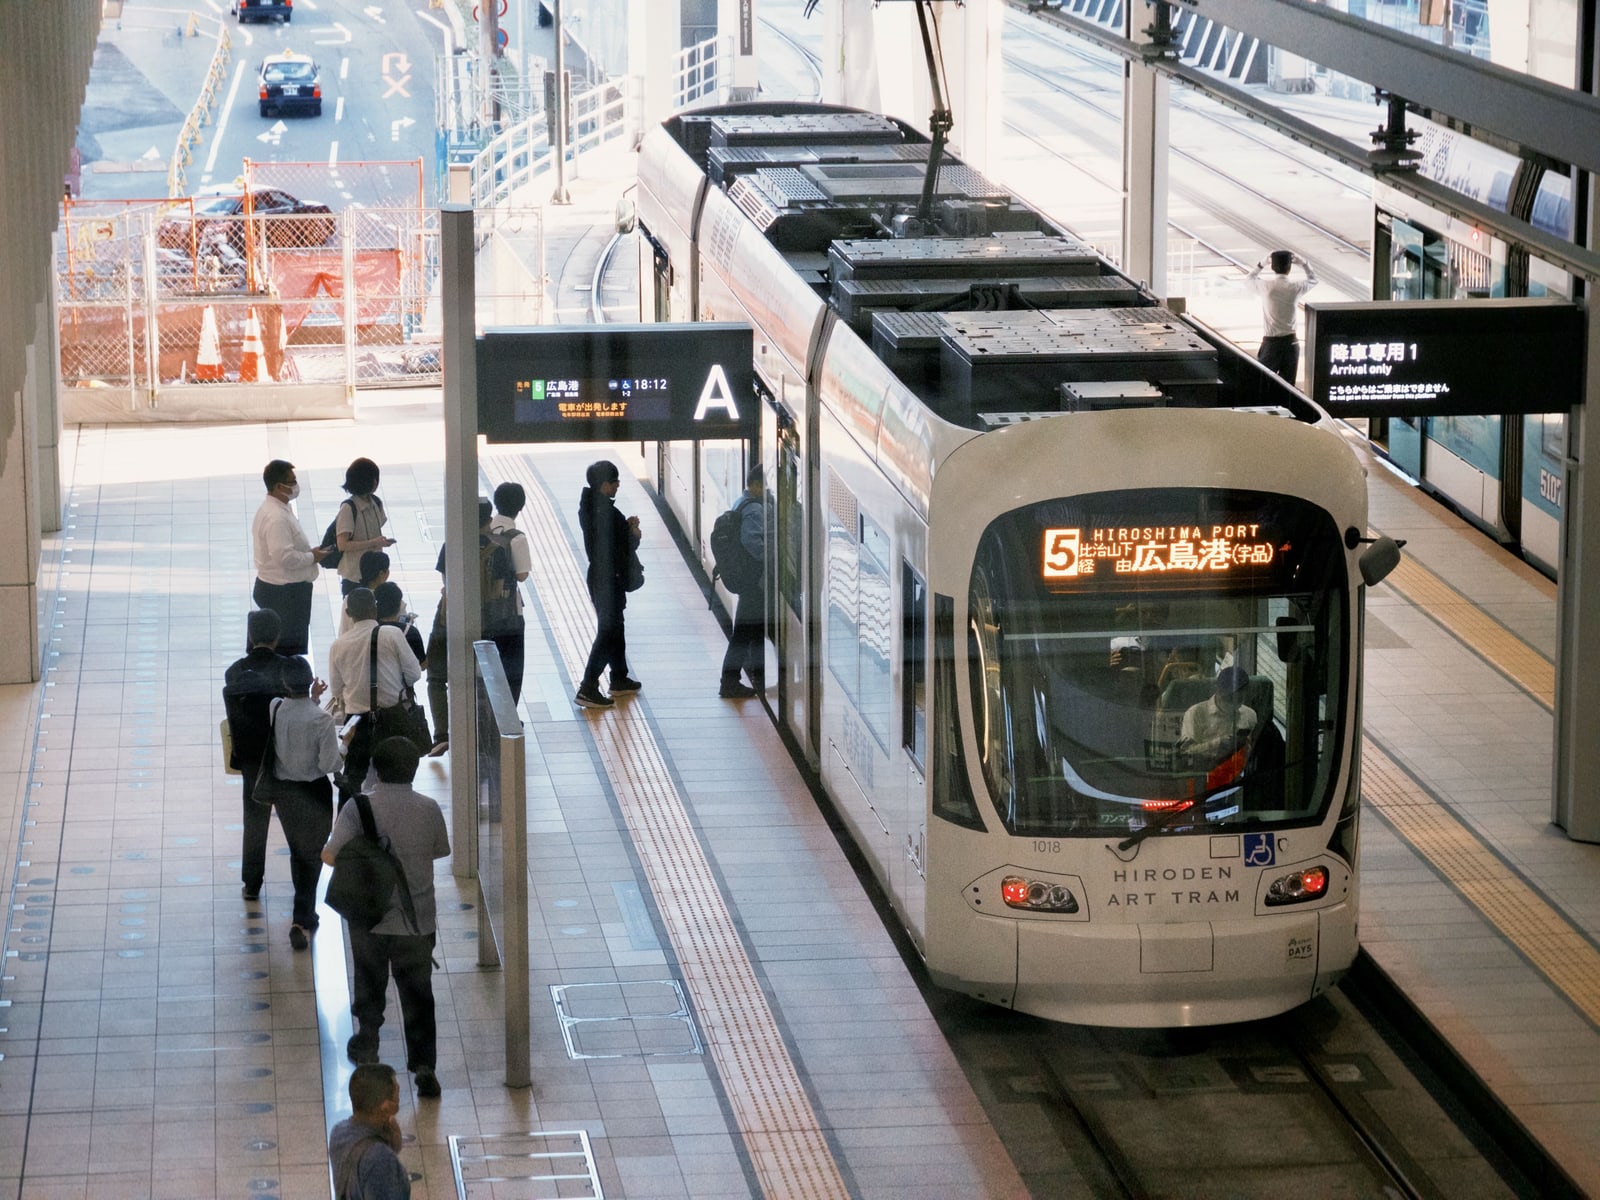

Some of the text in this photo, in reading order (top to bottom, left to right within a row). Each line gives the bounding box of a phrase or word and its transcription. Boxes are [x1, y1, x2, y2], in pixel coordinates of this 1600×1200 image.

[1330, 342, 1417, 362] 降車専用 1
[1330, 363, 1392, 376] Arrival only
[546, 380, 579, 391] 広島港
[634, 379, 667, 390] 18:12
[693, 364, 740, 420] A
[558, 402, 628, 412] 電車が出発します
[1093, 524, 1259, 541] HIROSHIMA PORT
[1046, 531, 1078, 573] 5
[1079, 541, 1134, 558] 比治山下
[1031, 840, 1061, 854] 1018
[1113, 866, 1231, 882] HIRODEN
[1107, 889, 1239, 906] ART TRAM
[1288, 944, 1312, 957] DAYS
